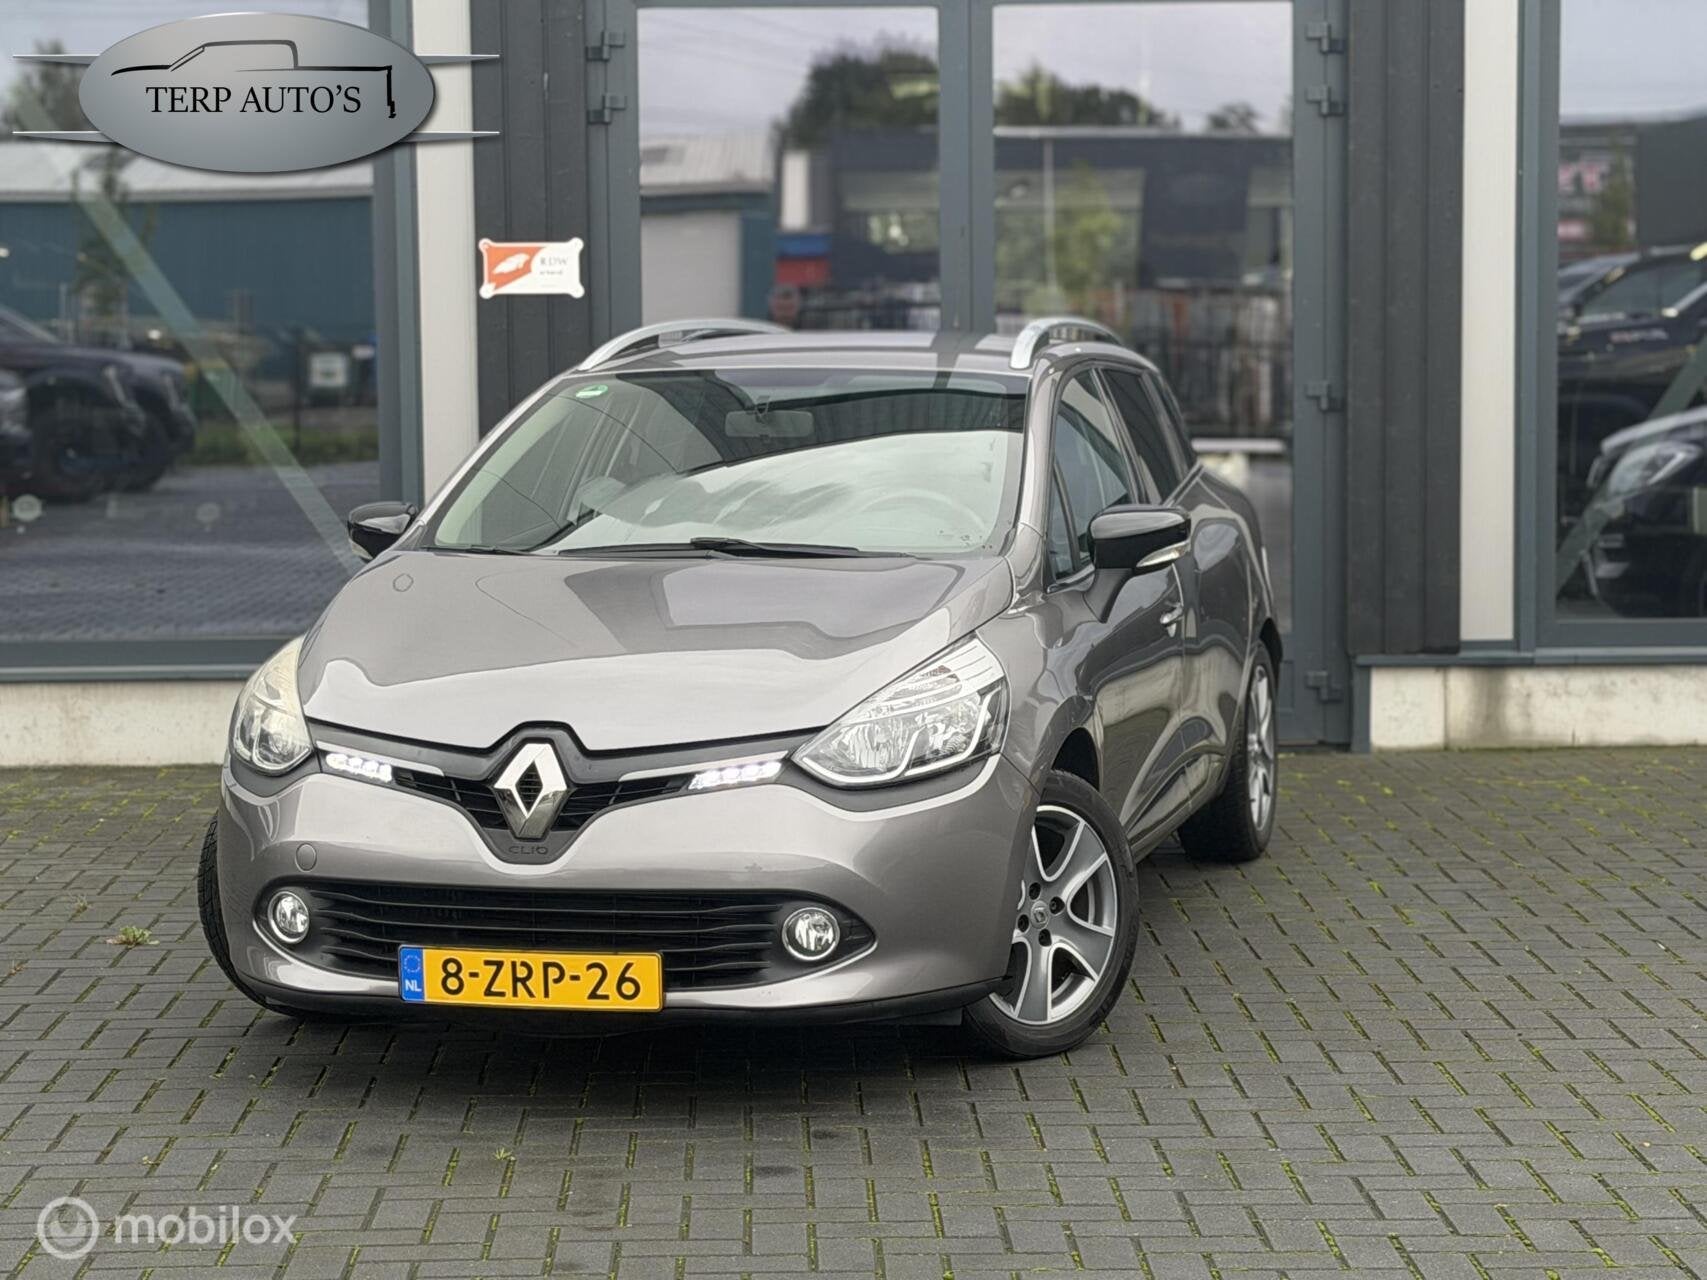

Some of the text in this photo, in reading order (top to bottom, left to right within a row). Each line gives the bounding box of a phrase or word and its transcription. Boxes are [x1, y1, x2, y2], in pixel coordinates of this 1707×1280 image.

[508, 845, 549, 855] CLIO
[404, 979, 422, 993] NL
[440, 957, 641, 1001] 8-ZRP-26
